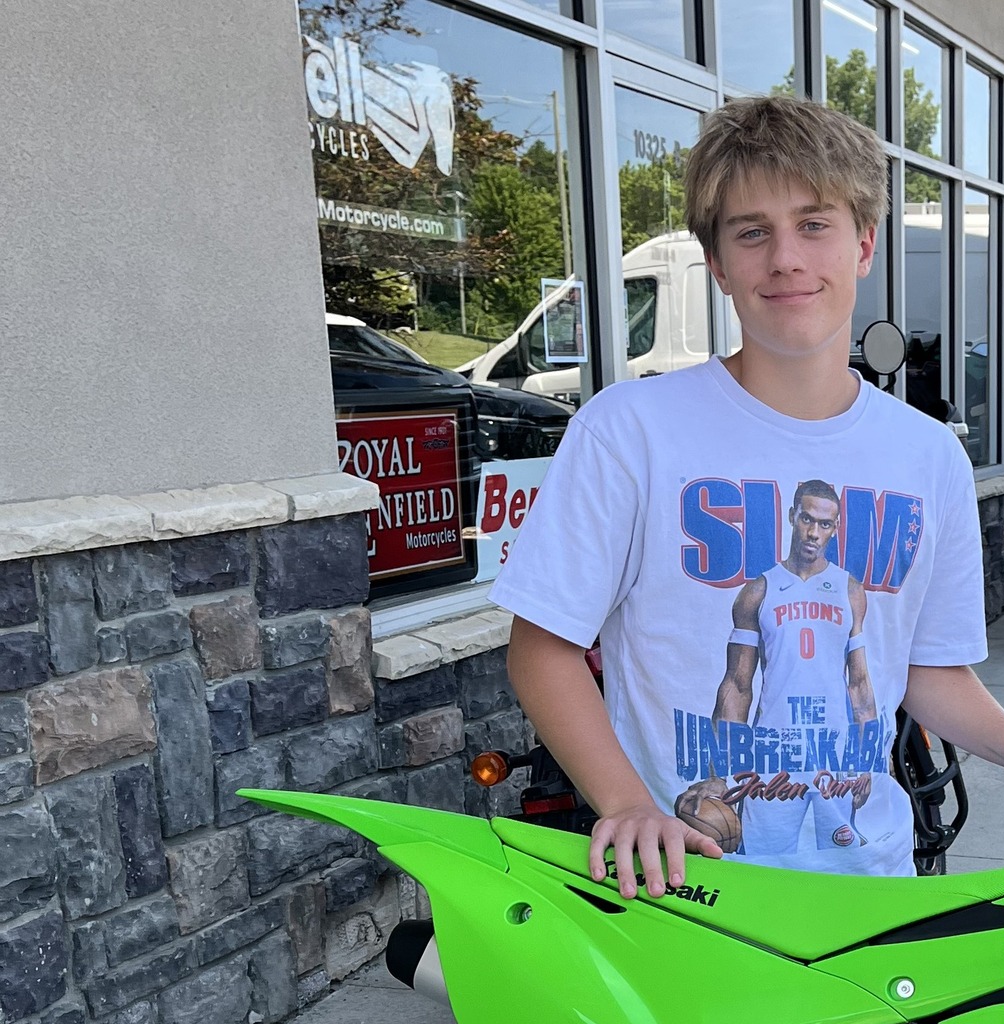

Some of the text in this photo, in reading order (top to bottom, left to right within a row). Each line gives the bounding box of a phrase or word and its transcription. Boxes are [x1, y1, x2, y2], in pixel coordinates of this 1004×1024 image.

[406, 527, 456, 549] Motorcycles
[773, 601, 844, 627] PISTONS
[800, 627, 815, 659] 0
[787, 696, 827, 725] THE
